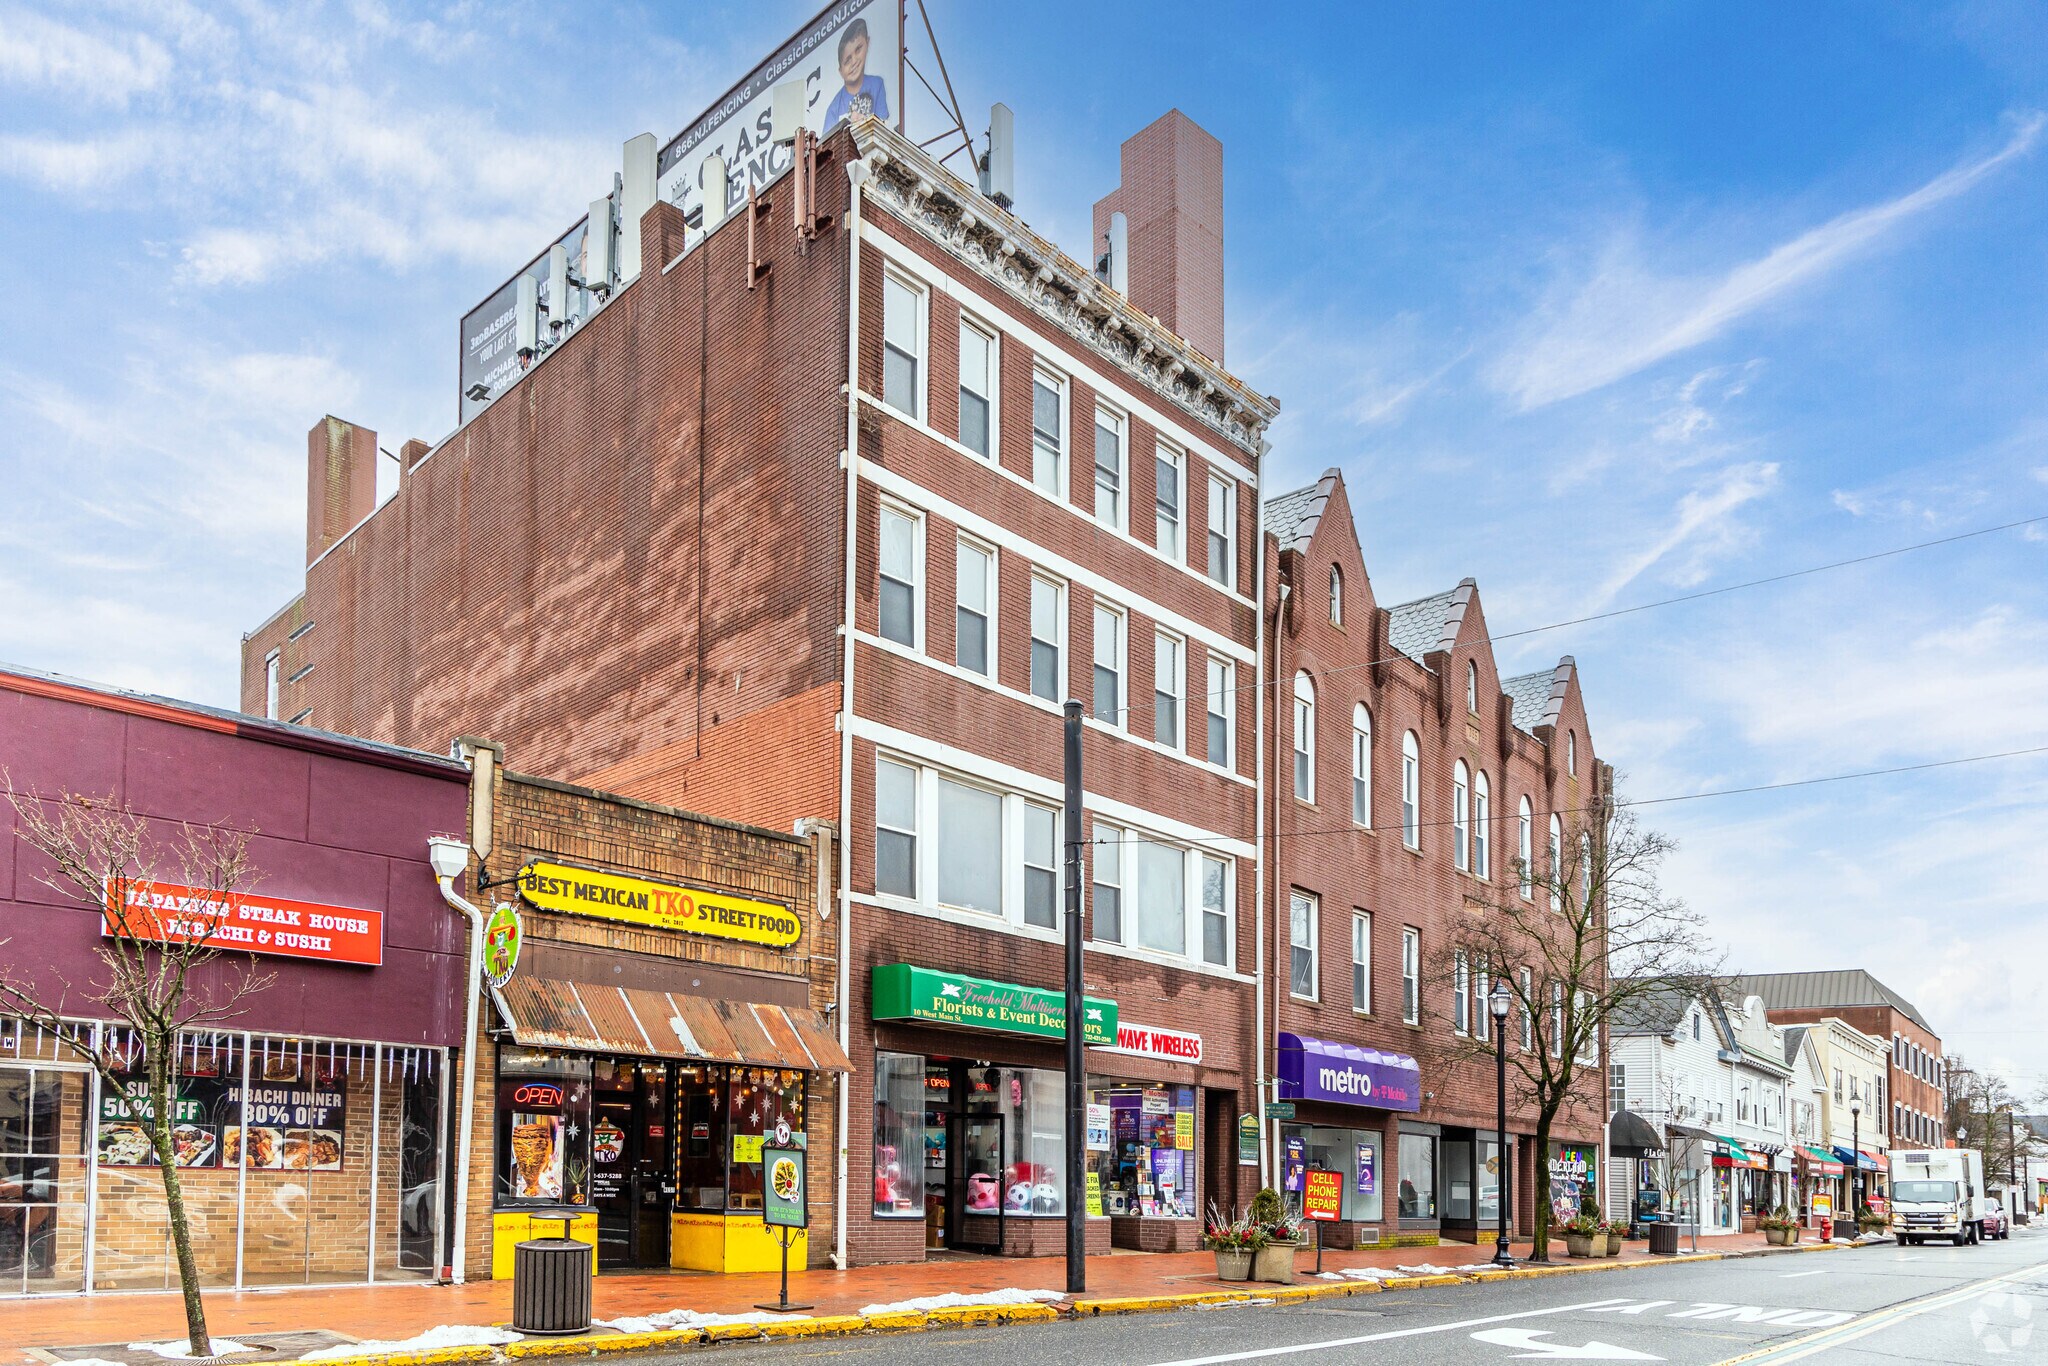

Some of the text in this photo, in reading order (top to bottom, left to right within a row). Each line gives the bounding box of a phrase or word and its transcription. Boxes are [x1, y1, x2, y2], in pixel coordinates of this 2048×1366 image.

[675, 0, 868, 159] 866.NJ.FENCING ClassicFenceNJ.co
[494, 333, 508, 355] LAST
[484, 356, 516, 386] MICHAEL
[126, 890, 368, 934] JAPANESE STEAK HOUSE
[526, 876, 795, 935] BEST MEXICAN TKO STREET FOOD
[257, 931, 272, 944] &
[275, 932, 332, 952] SUSHI
[959, 981, 1012, 1008] Freehold
[913, 1008, 922, 1016] 10
[922, 1009, 937, 1018] West
[938, 1012, 953, 1021] Main
[933, 996, 983, 1018] Florists
[986, 1007, 996, 1019] &
[1000, 1006, 1036, 1025] Event
[1117, 1027, 1200, 1059] WAVE WIRELESS
[930, 1078, 950, 1088] OPEN
[1320, 1066, 1371, 1097] metro
[1372, 1083, 1380, 1101] by
[1387, 1086, 1408, 1102] Mobile
[291, 1091, 342, 1108] DINNER
[514, 1086, 564, 1105] OPEN
[104, 1097, 155, 1118] 50%
[295, 1107, 328, 1126] OFF
[1177, 1135, 1192, 1148] SALE
[595, 1150, 616, 1162] TKO
[1648, 1149, 1656, 1157] La
[1313, 1173, 1334, 1185] CELL
[1570, 1173, 1586, 1183] Shop
[1308, 1185, 1338, 1198] PHONE
[1306, 1198, 1338, 1210] REPAIR
